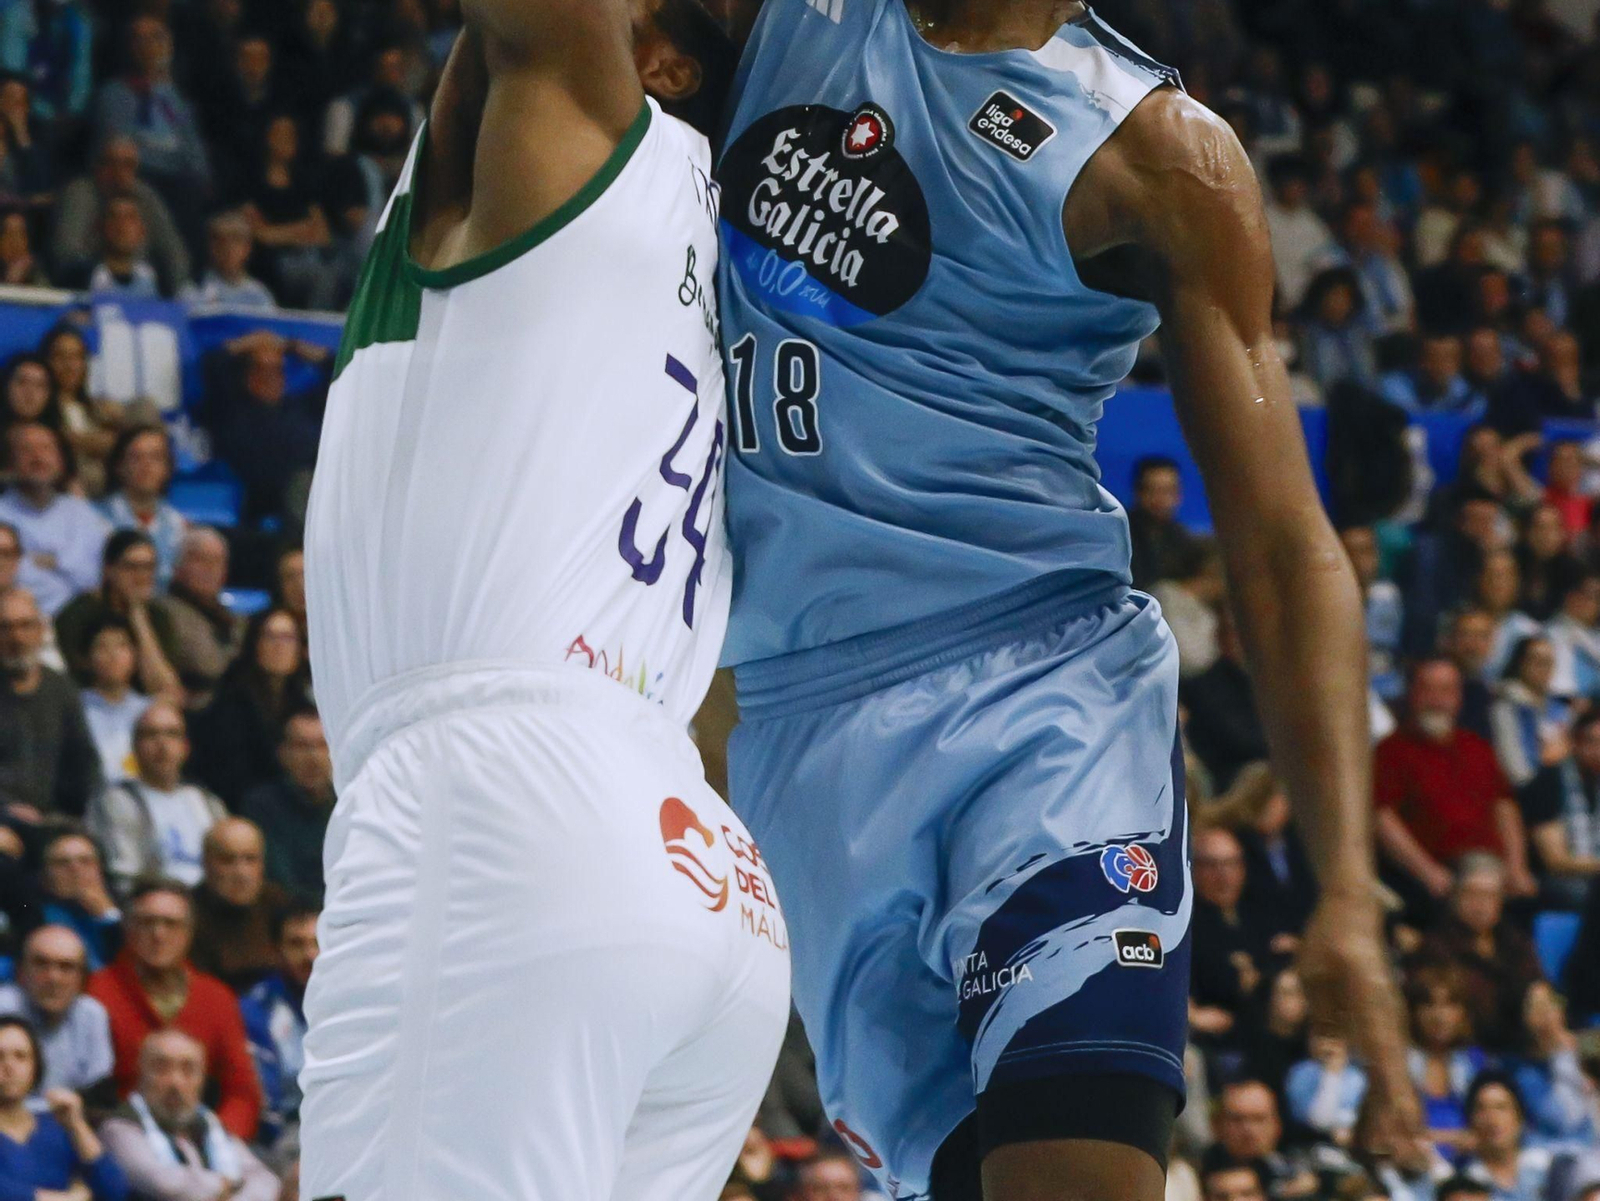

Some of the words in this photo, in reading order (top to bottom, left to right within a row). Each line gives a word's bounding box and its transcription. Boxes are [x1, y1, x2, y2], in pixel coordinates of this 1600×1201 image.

[977, 117, 1032, 156] endesa
[985, 103, 1014, 128] liga
[761, 128, 899, 245] Estrella
[748, 178, 865, 287] Galicia
[729, 331, 823, 456] 18
[735, 864, 776, 910] DEL
[1122, 943, 1155, 961] acb
[962, 963, 1034, 1000] GALICIA
